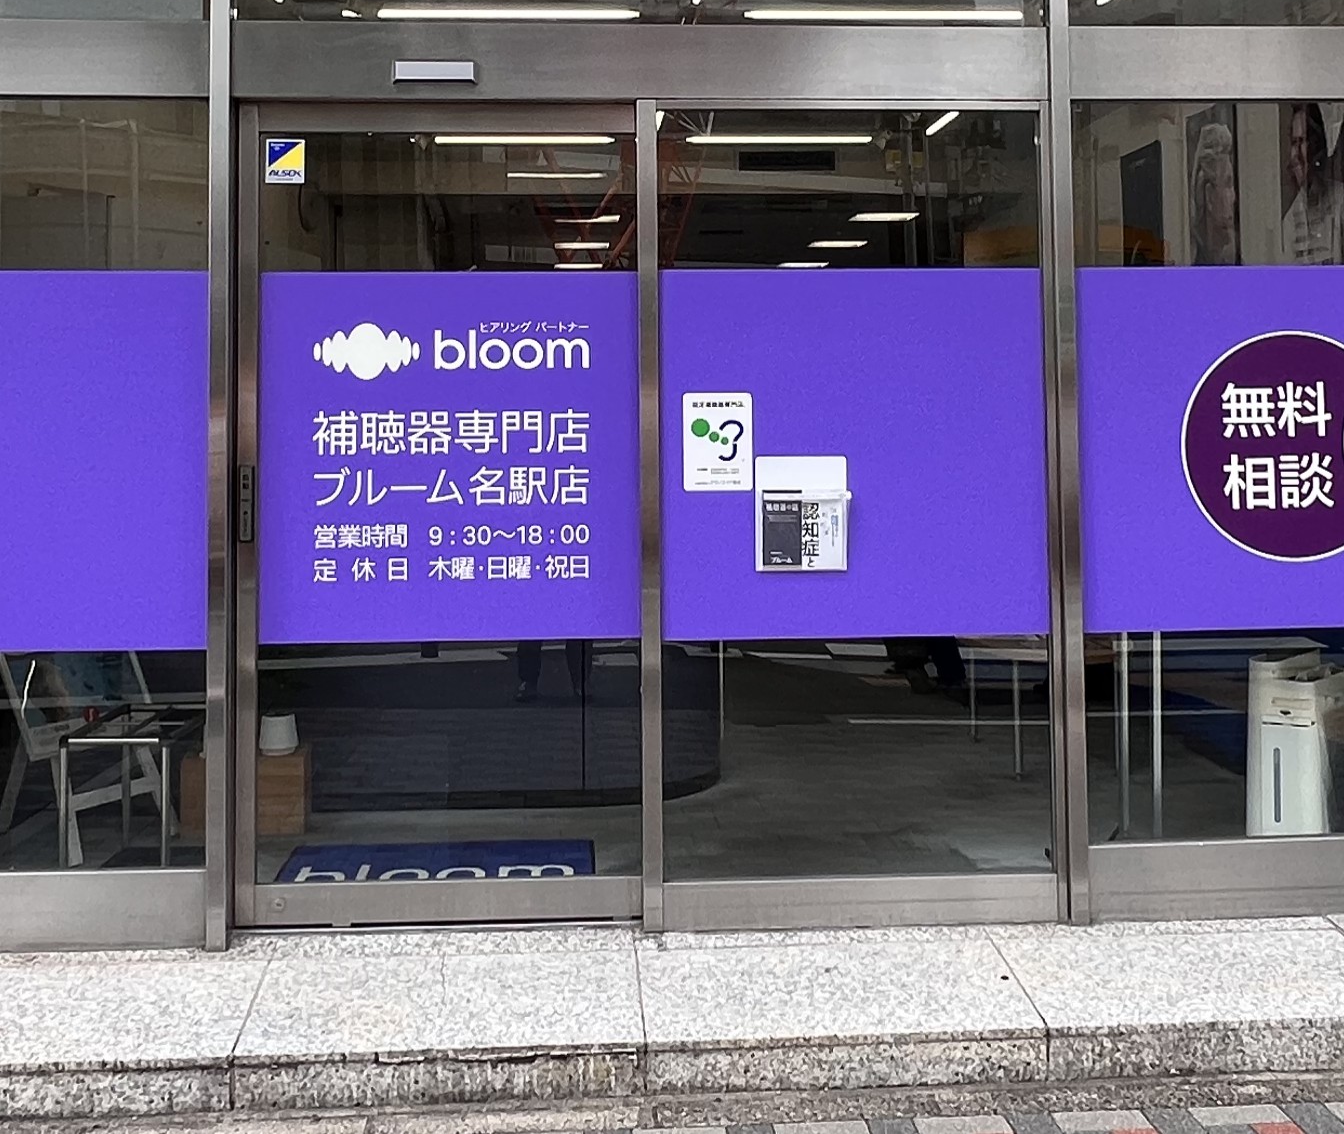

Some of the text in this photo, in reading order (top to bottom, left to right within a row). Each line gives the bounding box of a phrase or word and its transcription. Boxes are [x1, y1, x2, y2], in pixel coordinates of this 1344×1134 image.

[479, 321, 589, 333] ヒアリング パートナー
[434, 329, 590, 370] bloom
[1221, 381, 1332, 438] 無料
[312, 408, 590, 456] 補聴器専門店
[313, 464, 590, 506] ブルーム名駅店
[1223, 452, 1335, 510] 相談
[313, 523, 408, 549] 営業時間
[313, 557, 408, 583] 定休日
